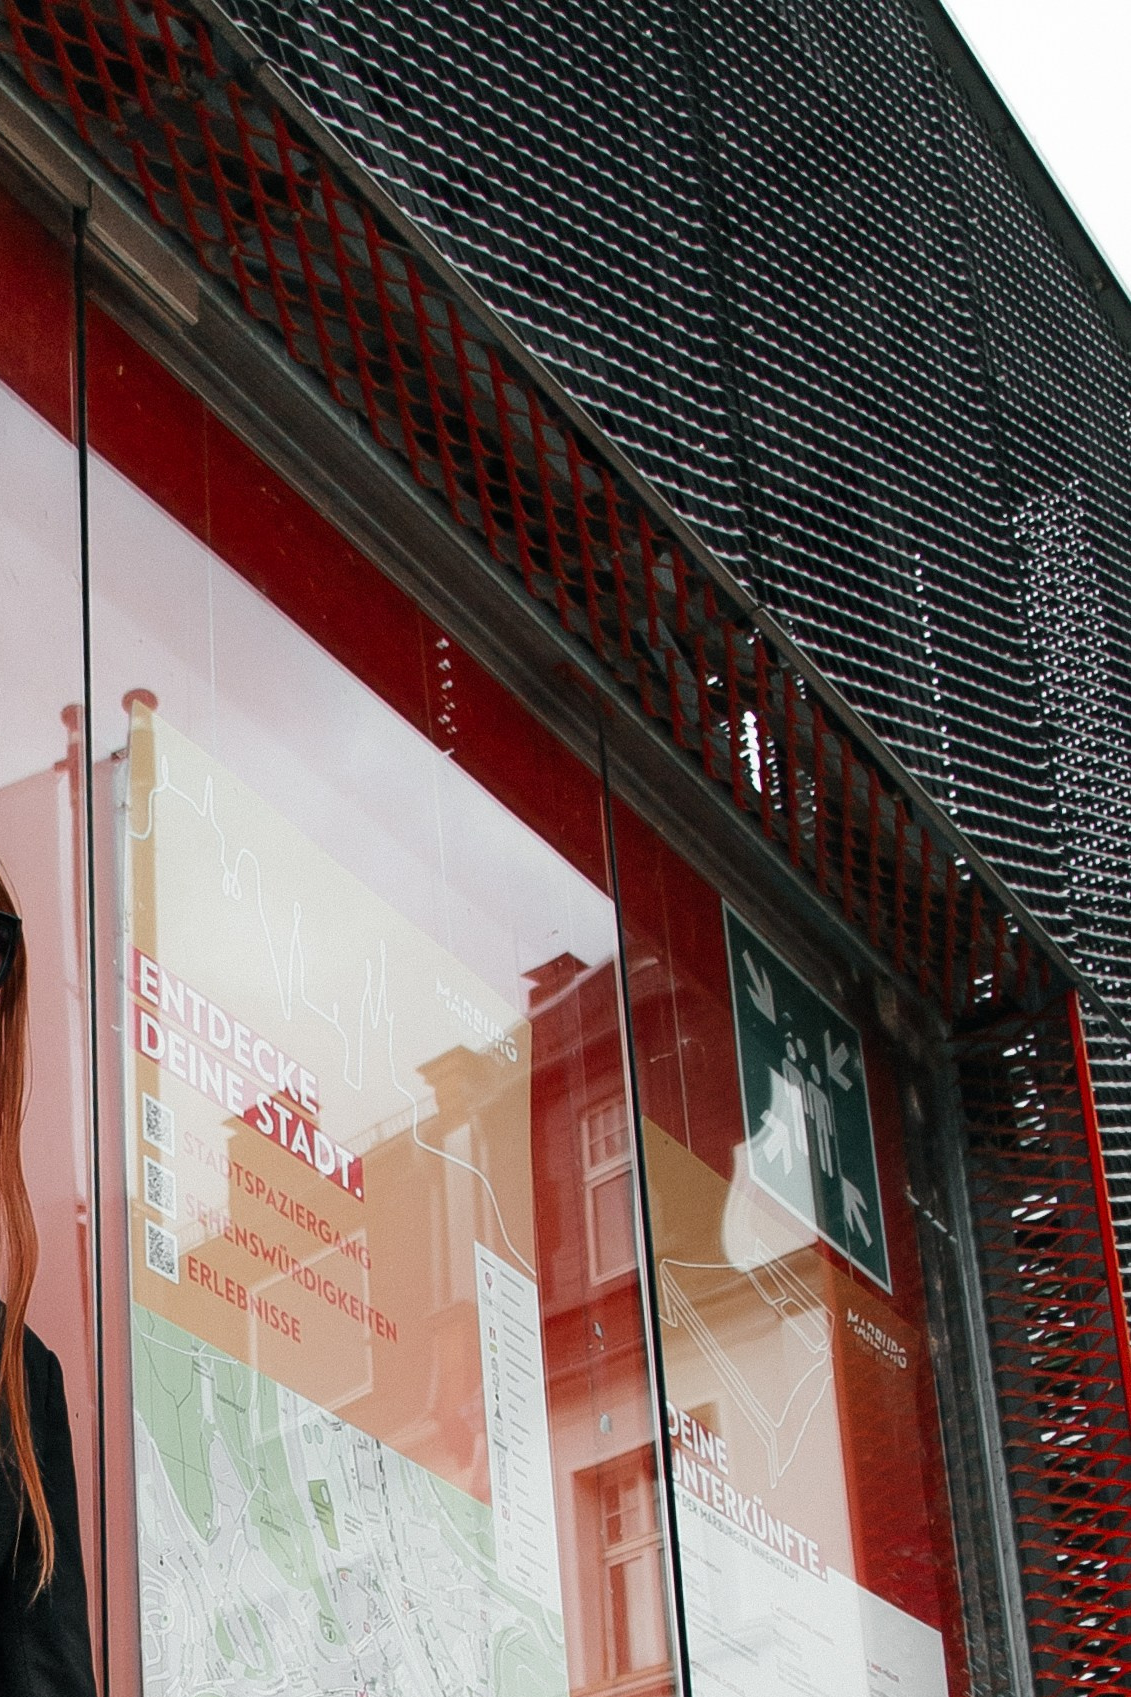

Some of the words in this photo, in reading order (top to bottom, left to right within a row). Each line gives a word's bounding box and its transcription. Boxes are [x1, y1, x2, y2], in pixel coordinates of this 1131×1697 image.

[140, 954, 319, 1115] ENTDECKE
[140, 1016, 245, 1119] DEINE
[256, 1094, 365, 1199] STADT.
[183, 1131, 372, 1271] STADTSPAZIERGANG
[184, 1193, 398, 1343] SEHENSWÜRDIGKEITEN
[187, 1255, 302, 1344] ERLEBNISSE
[845, 1307, 908, 1370] MARBURG
